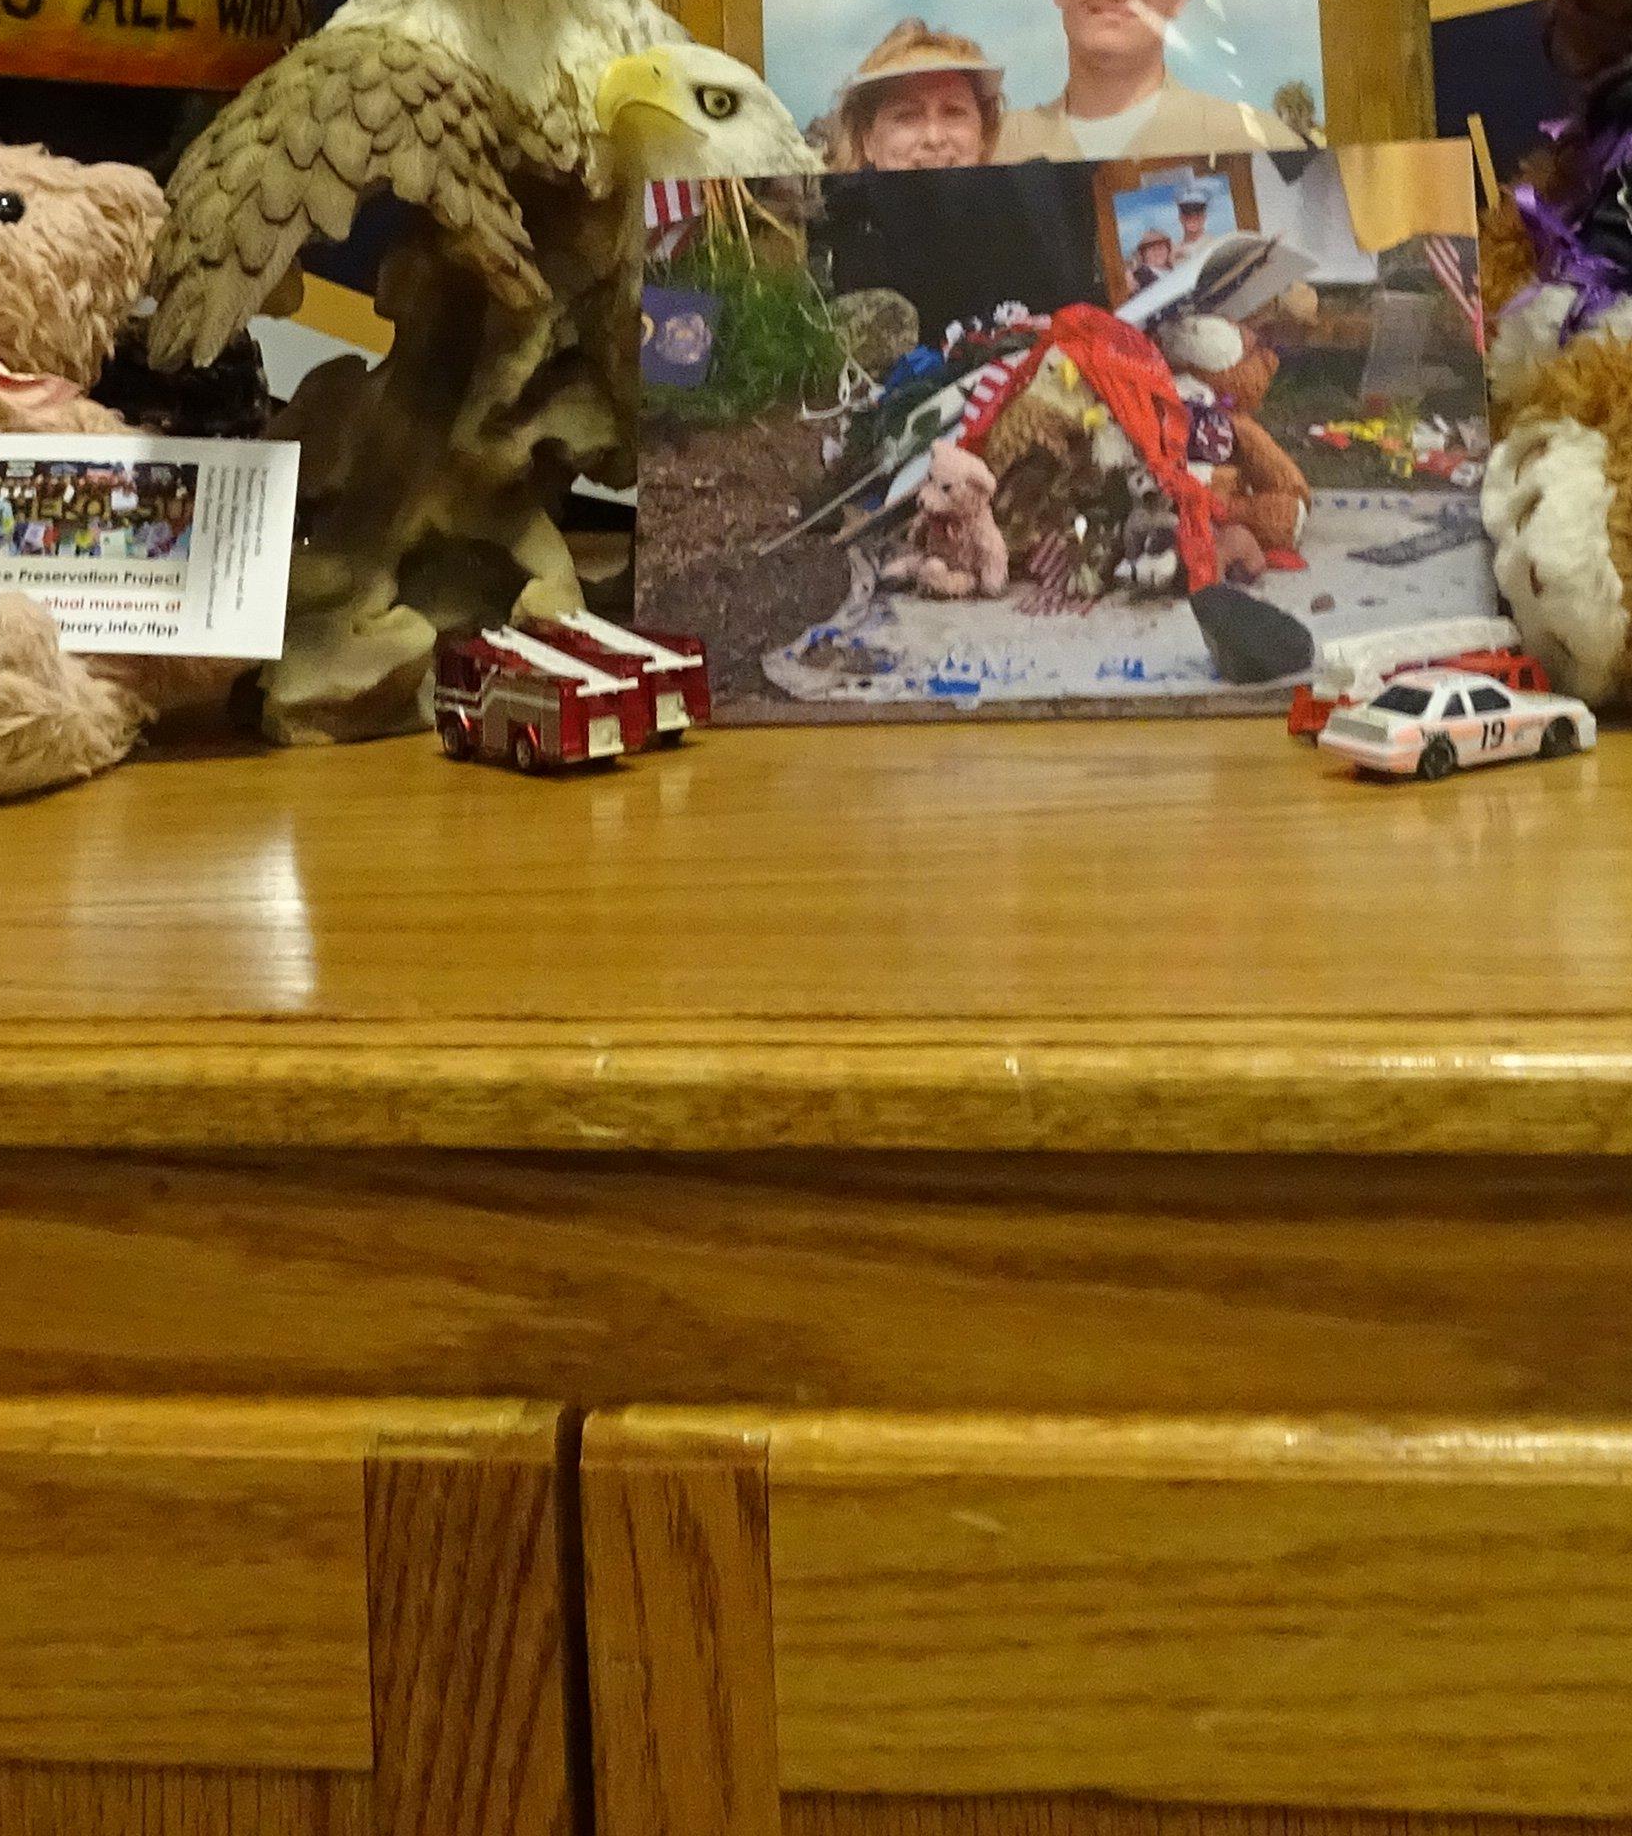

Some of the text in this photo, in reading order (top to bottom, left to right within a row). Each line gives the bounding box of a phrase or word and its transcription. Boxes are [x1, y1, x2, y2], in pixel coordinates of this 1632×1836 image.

[18, 568, 119, 584] Preservation
[123, 570, 181, 588] Project
[89, 598, 160, 612] museum
[164, 598, 181, 613] at
[1480, 719, 1507, 751] 19
